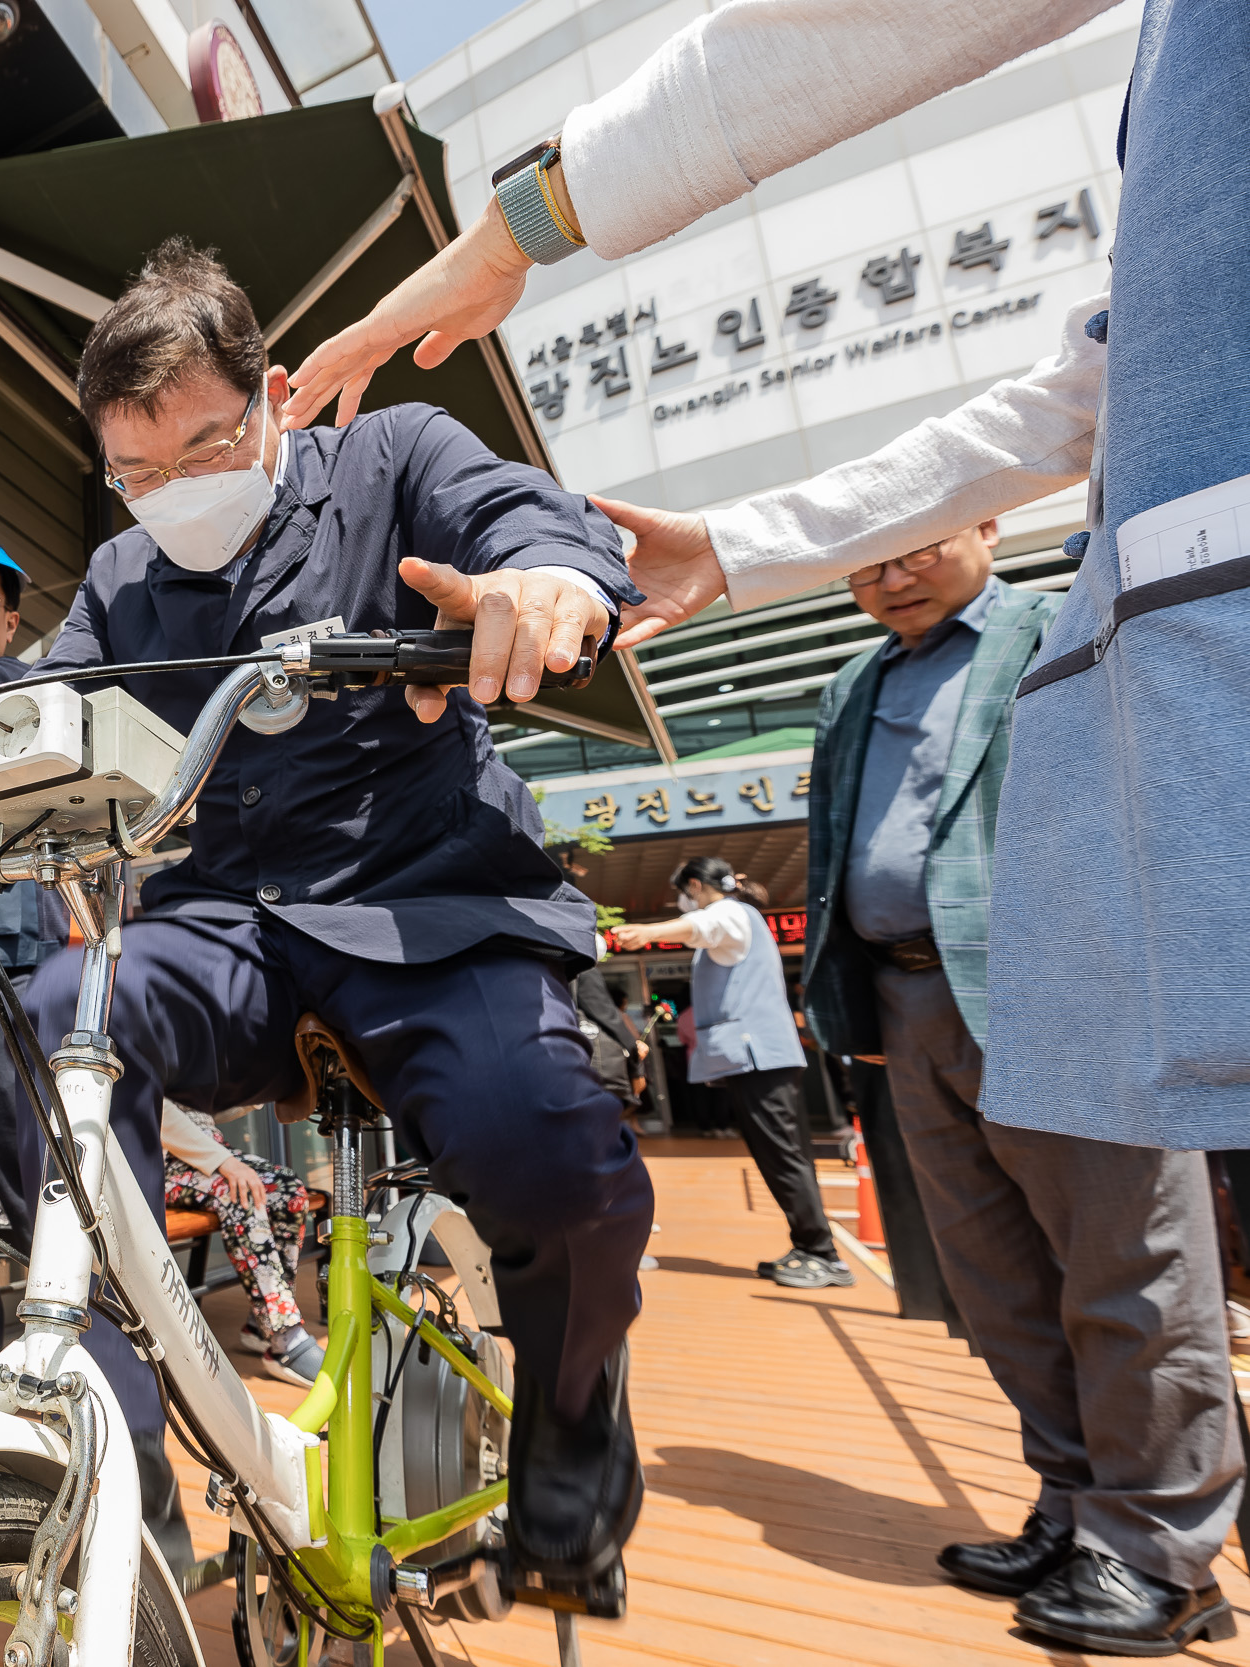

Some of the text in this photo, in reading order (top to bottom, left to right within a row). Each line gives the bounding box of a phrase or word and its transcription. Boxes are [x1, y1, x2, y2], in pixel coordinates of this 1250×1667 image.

[528, 297, 657, 368] 서울특별시
[654, 290, 1043, 423] Gwangjin Senior Welfare Center
